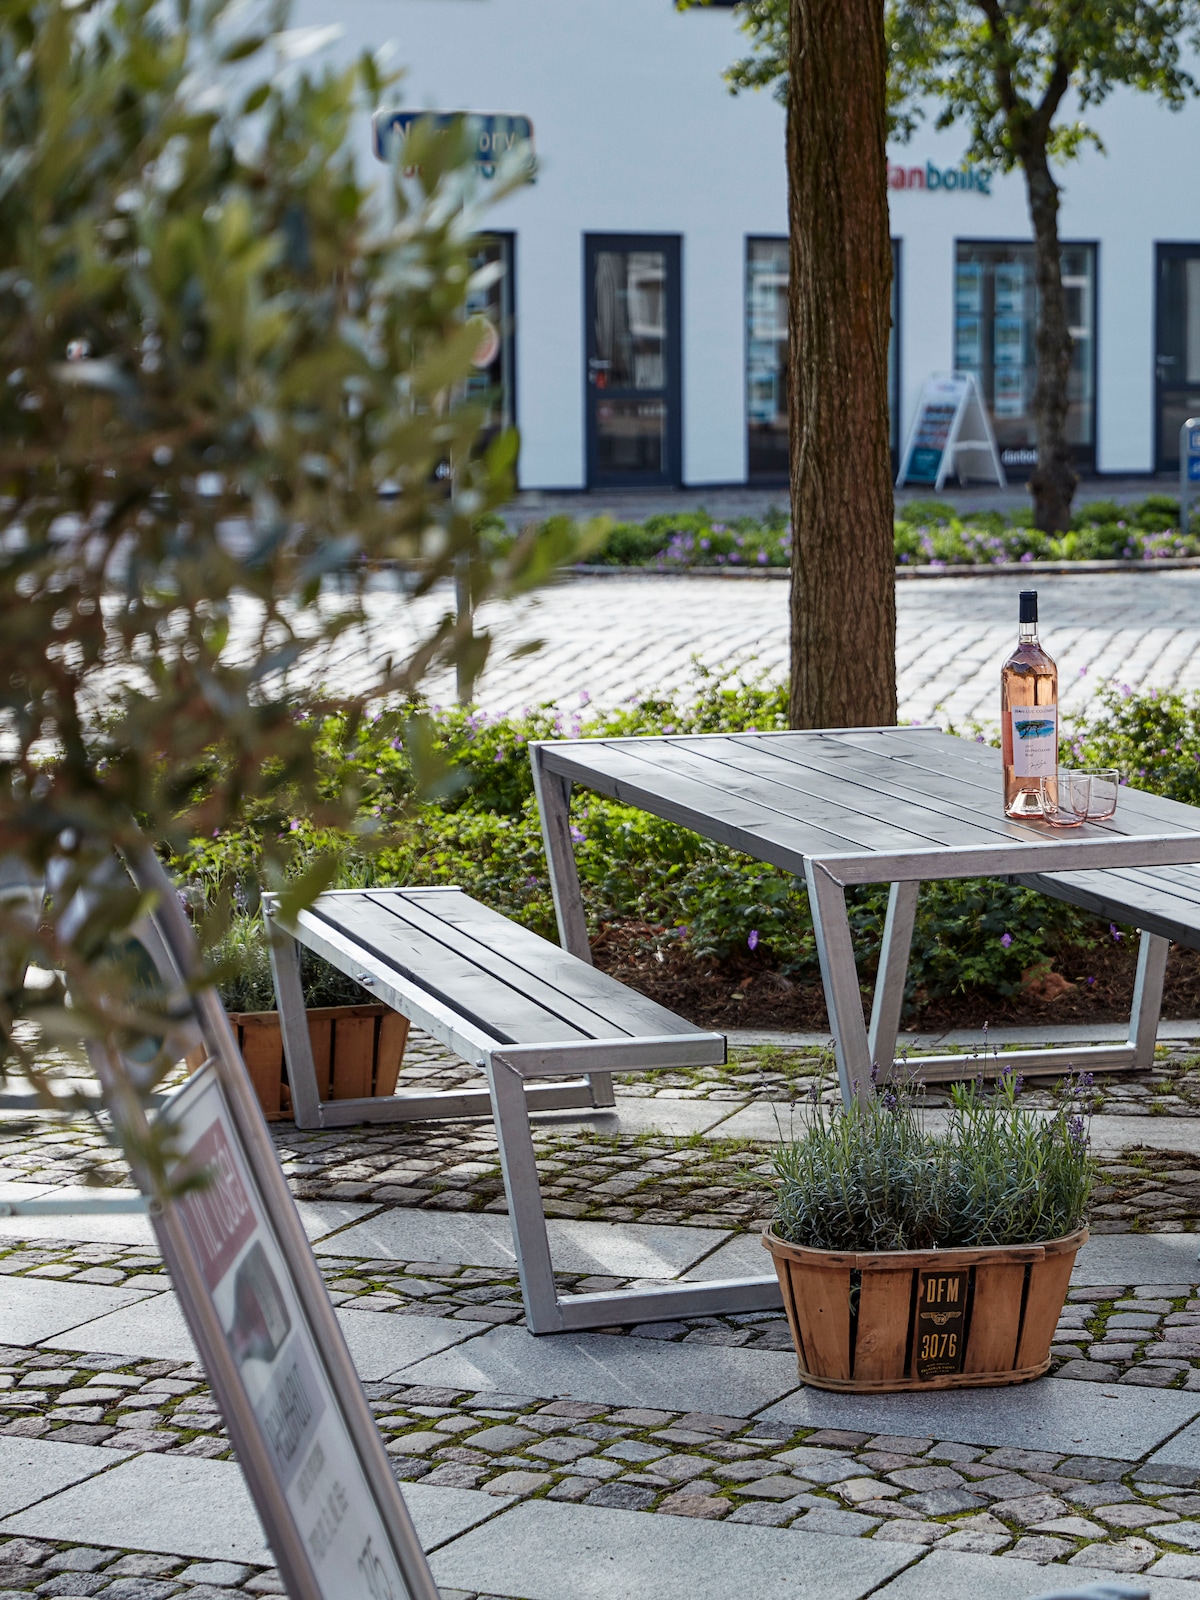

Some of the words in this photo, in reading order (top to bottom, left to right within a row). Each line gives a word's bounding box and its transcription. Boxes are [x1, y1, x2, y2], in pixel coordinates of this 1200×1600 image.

[886, 159, 991, 195] anbolig
[1001, 448, 1039, 466] danbol
[926, 1278, 960, 1303] DFM
[921, 1333, 957, 1360] 3076
